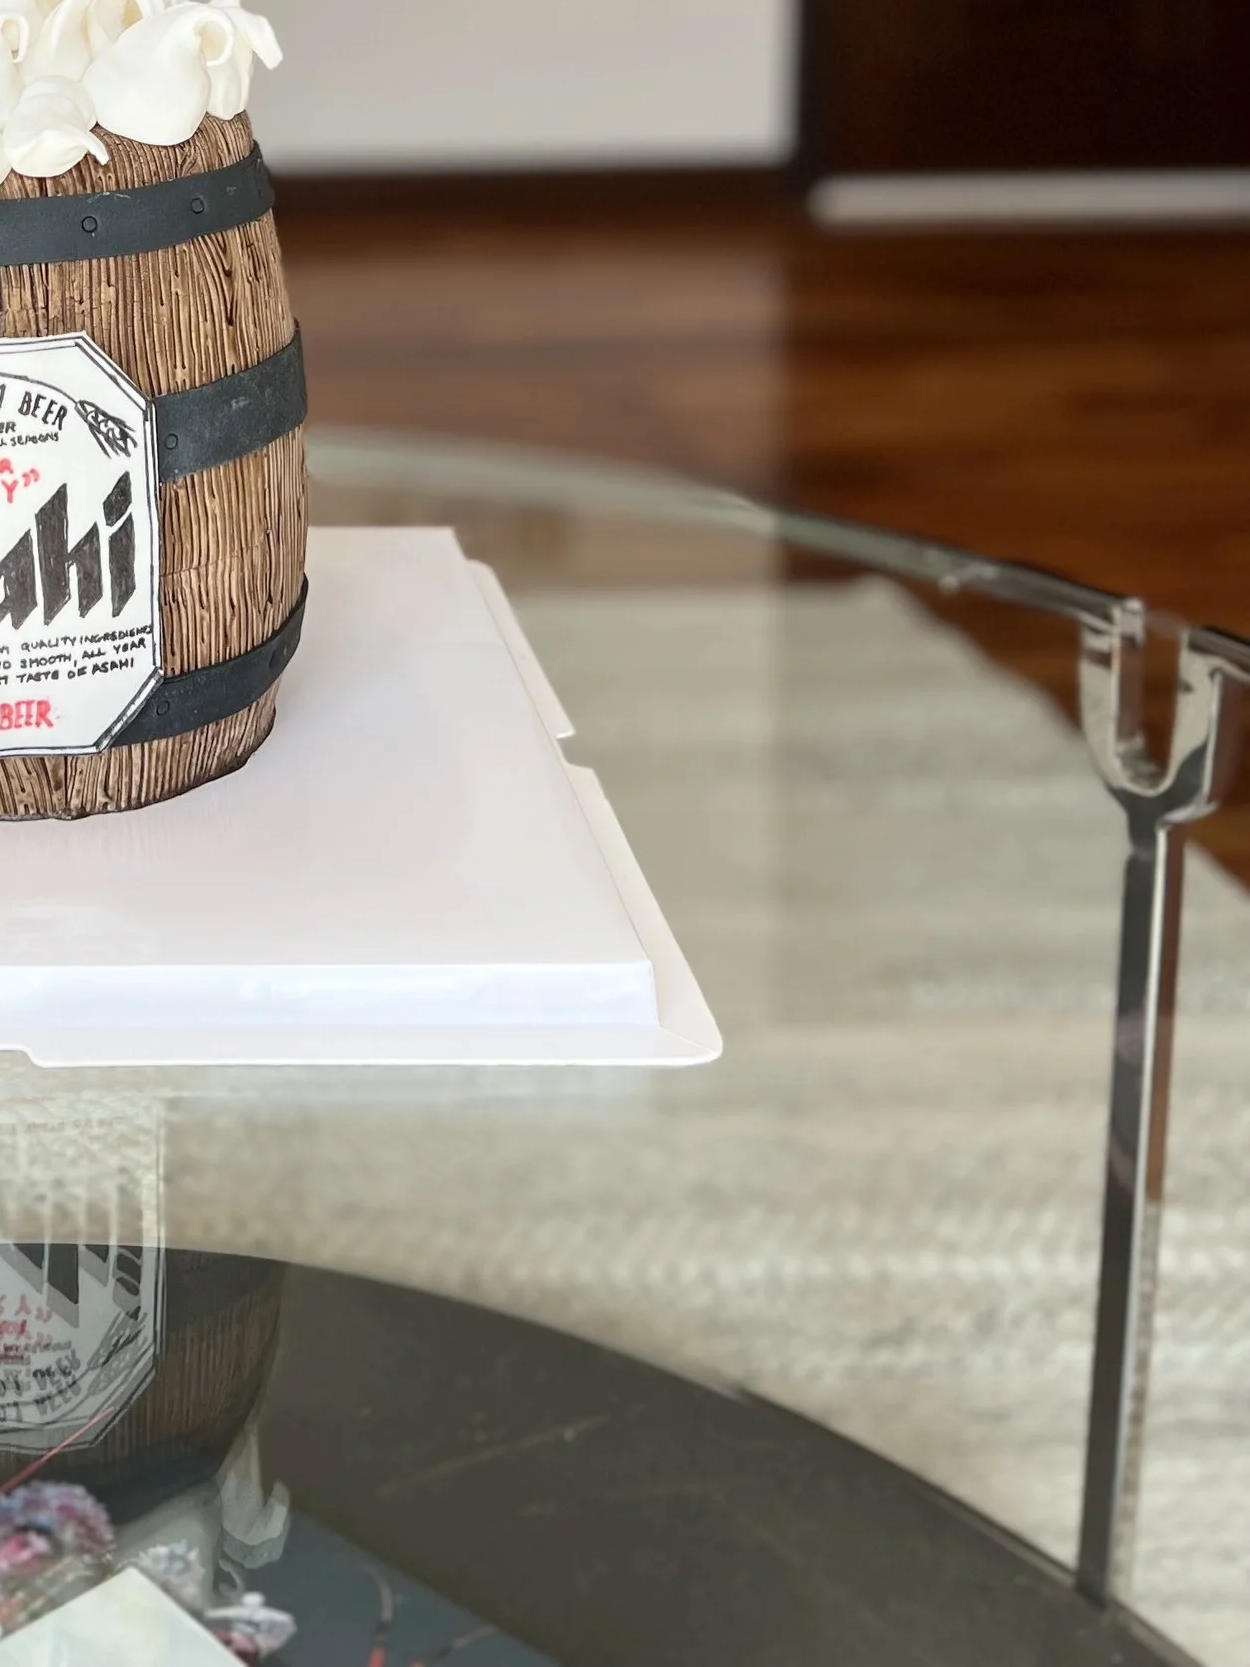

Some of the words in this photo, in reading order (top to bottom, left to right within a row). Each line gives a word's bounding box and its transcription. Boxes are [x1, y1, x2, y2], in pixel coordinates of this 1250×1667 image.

[18, 390, 68, 430] BEER
[21, 636, 76, 652] QUALITY
[82, 648, 106, 660] ALL
[113, 638, 146, 654] YEAR
[16, 670, 59, 684] TASTE
[92, 658, 134, 675] ASAHI
[0, 700, 54, 732] BEER
